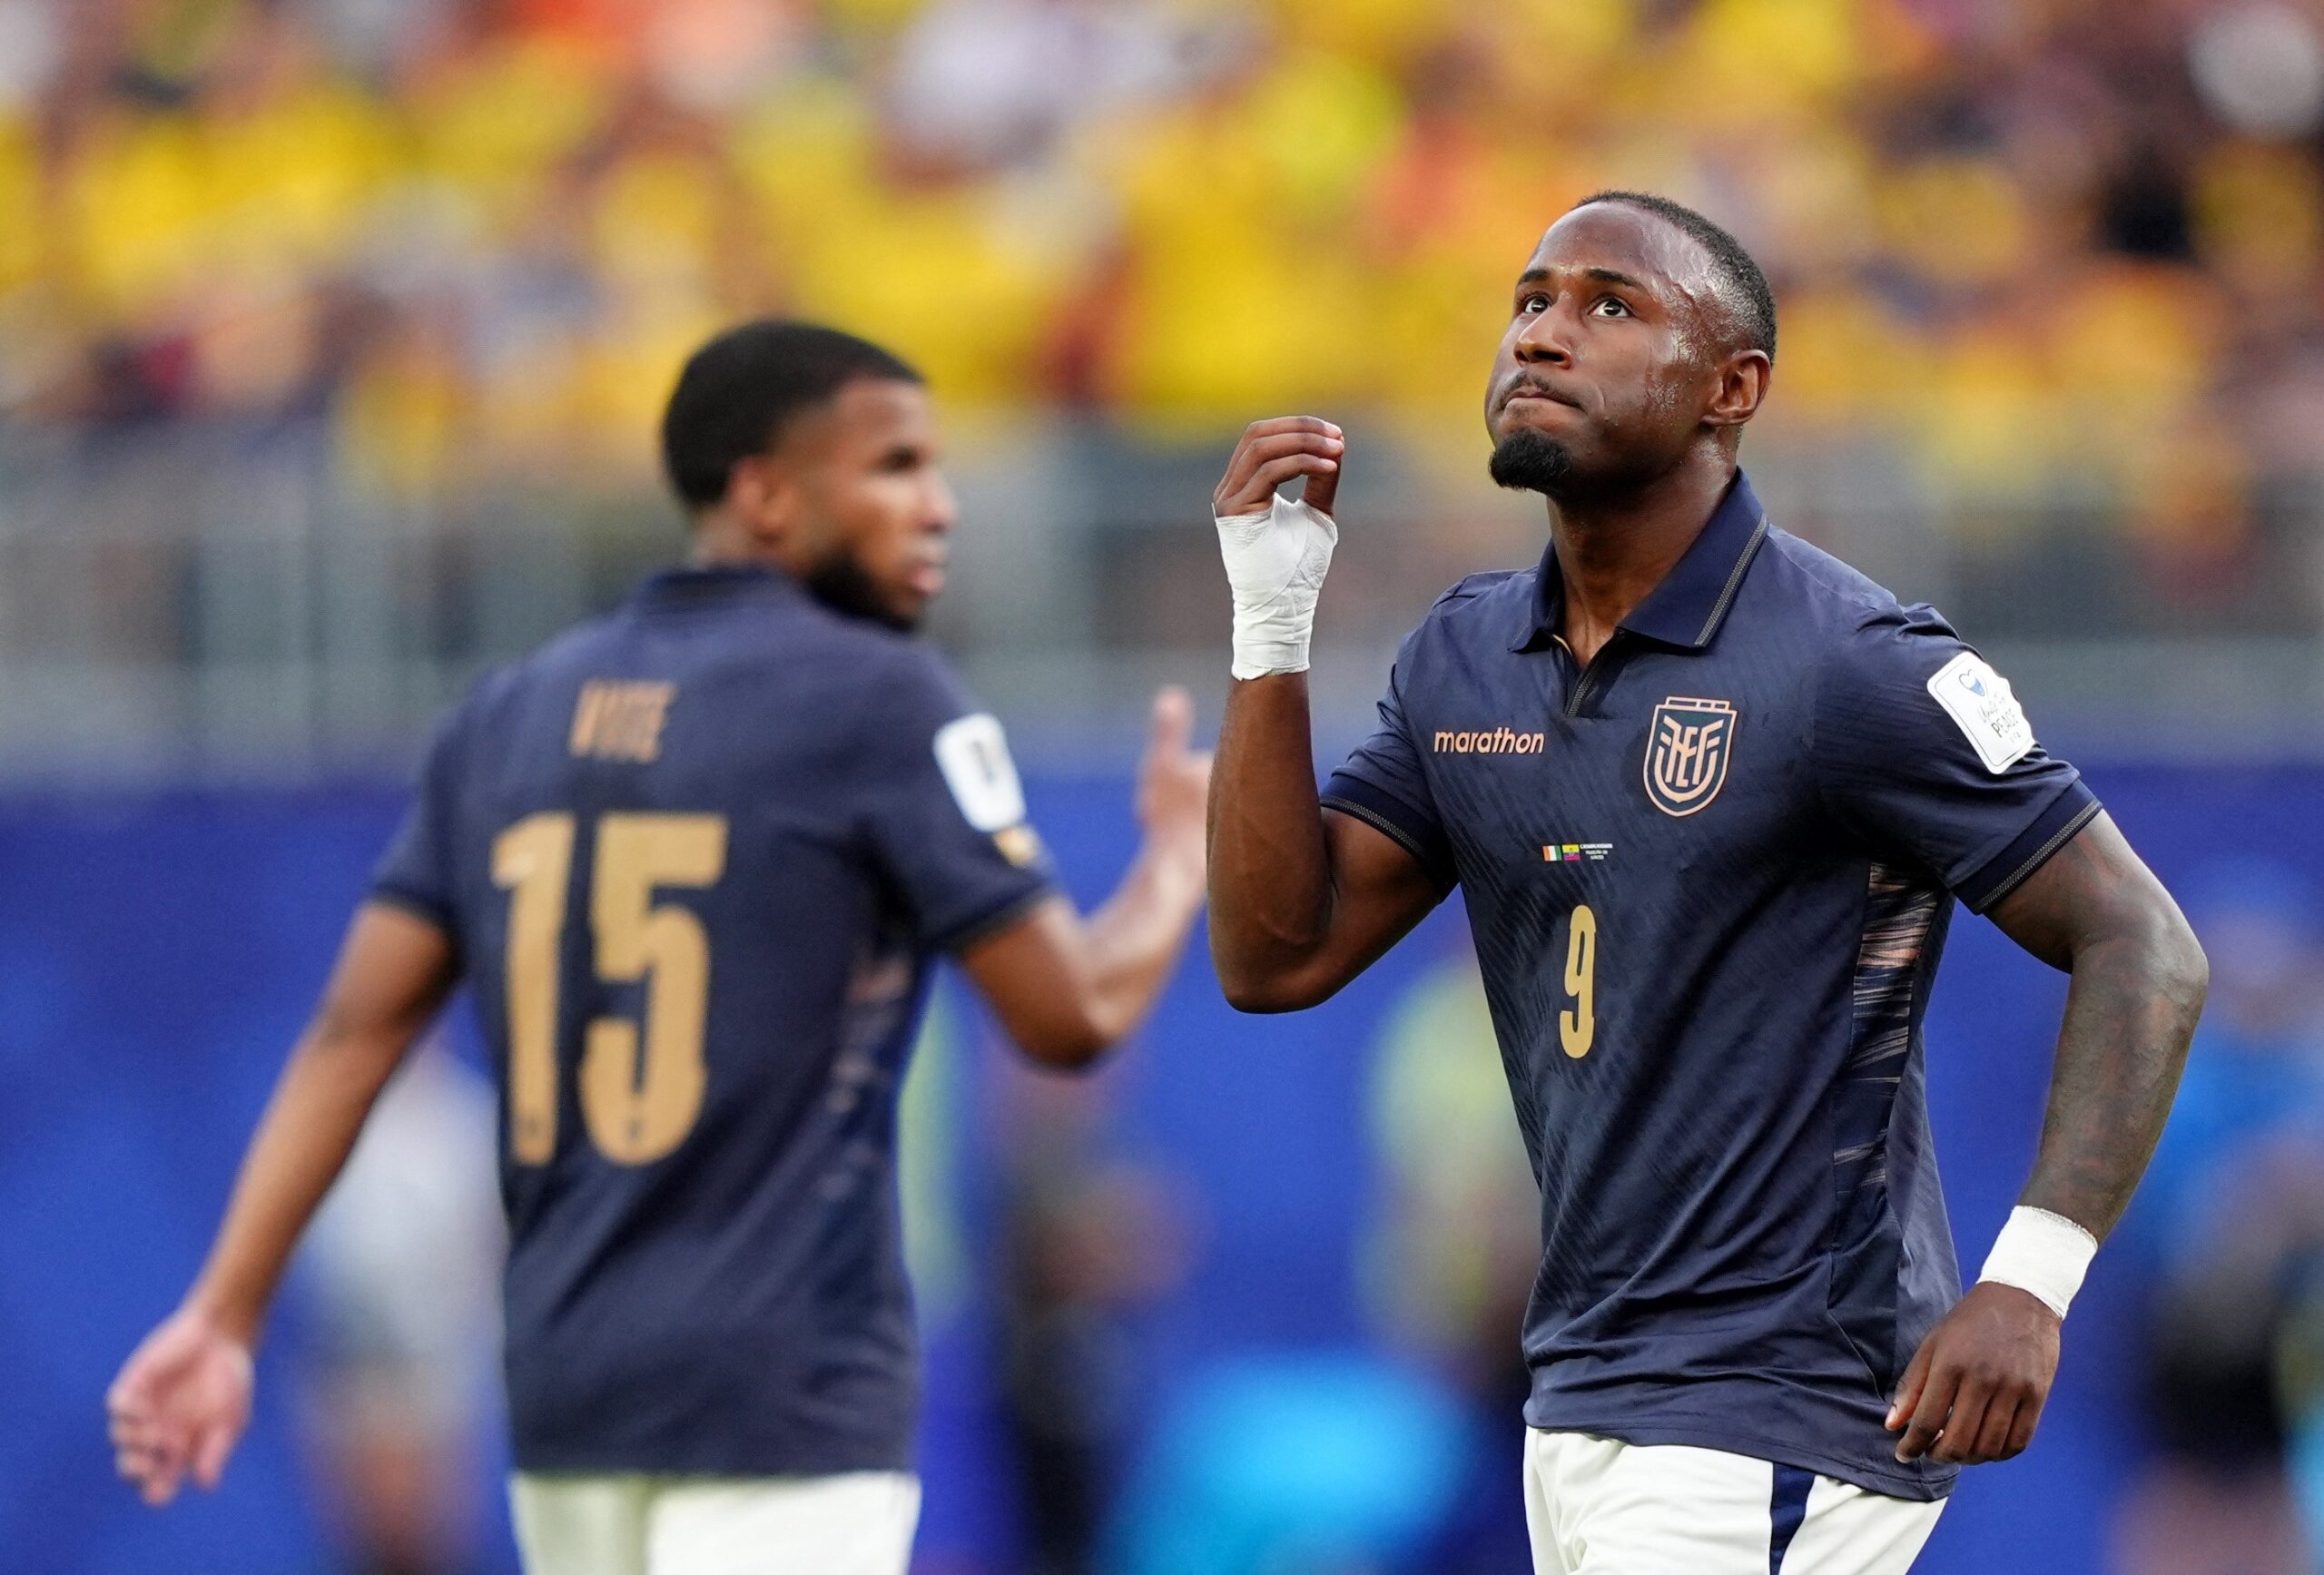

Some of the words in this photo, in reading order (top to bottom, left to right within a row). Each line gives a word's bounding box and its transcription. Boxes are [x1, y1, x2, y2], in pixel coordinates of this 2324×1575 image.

[1433, 726, 1545, 753] marathon
[491, 812, 729, 1166] 15
[1559, 904, 1596, 1059] 9
